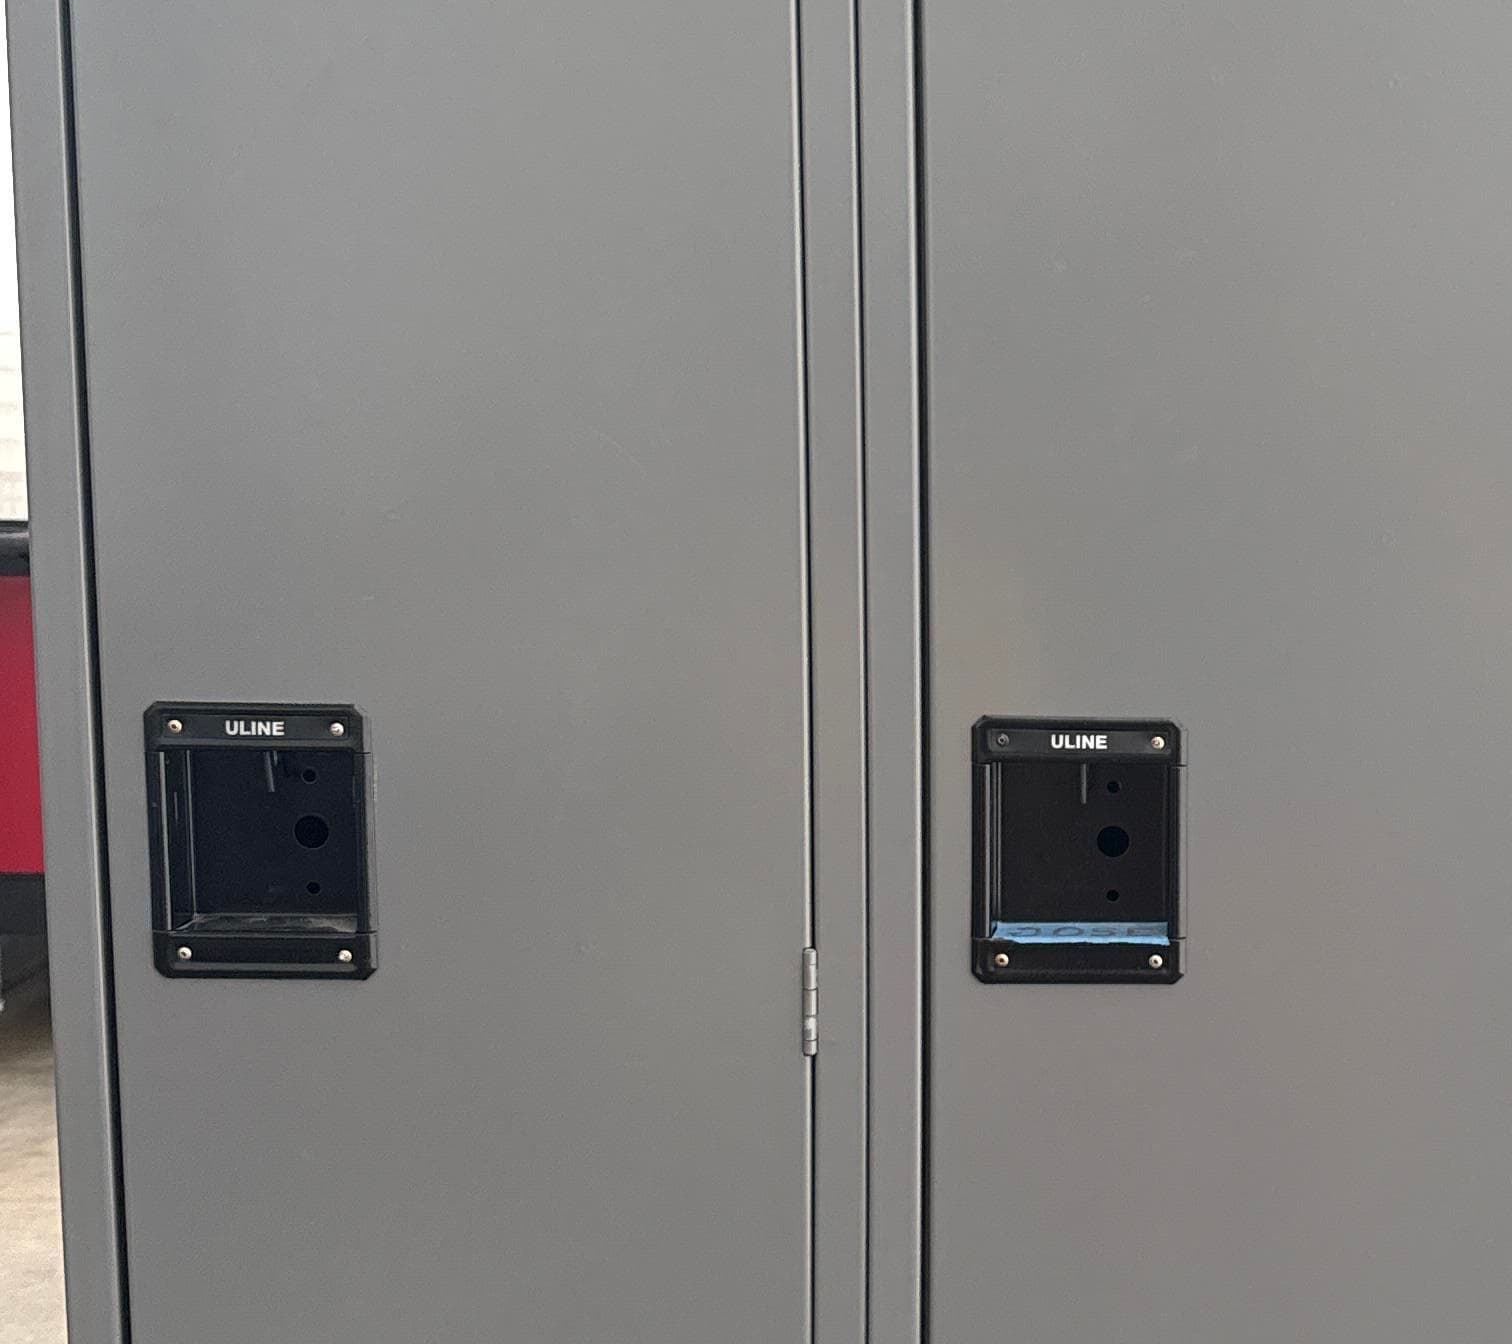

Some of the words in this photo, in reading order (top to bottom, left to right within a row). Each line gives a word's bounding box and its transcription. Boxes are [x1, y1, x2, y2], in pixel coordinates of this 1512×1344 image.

[225, 720, 285, 736] ULINE
[1051, 734, 1108, 750] ULINE
[1008, 925, 1156, 937] JOSE
